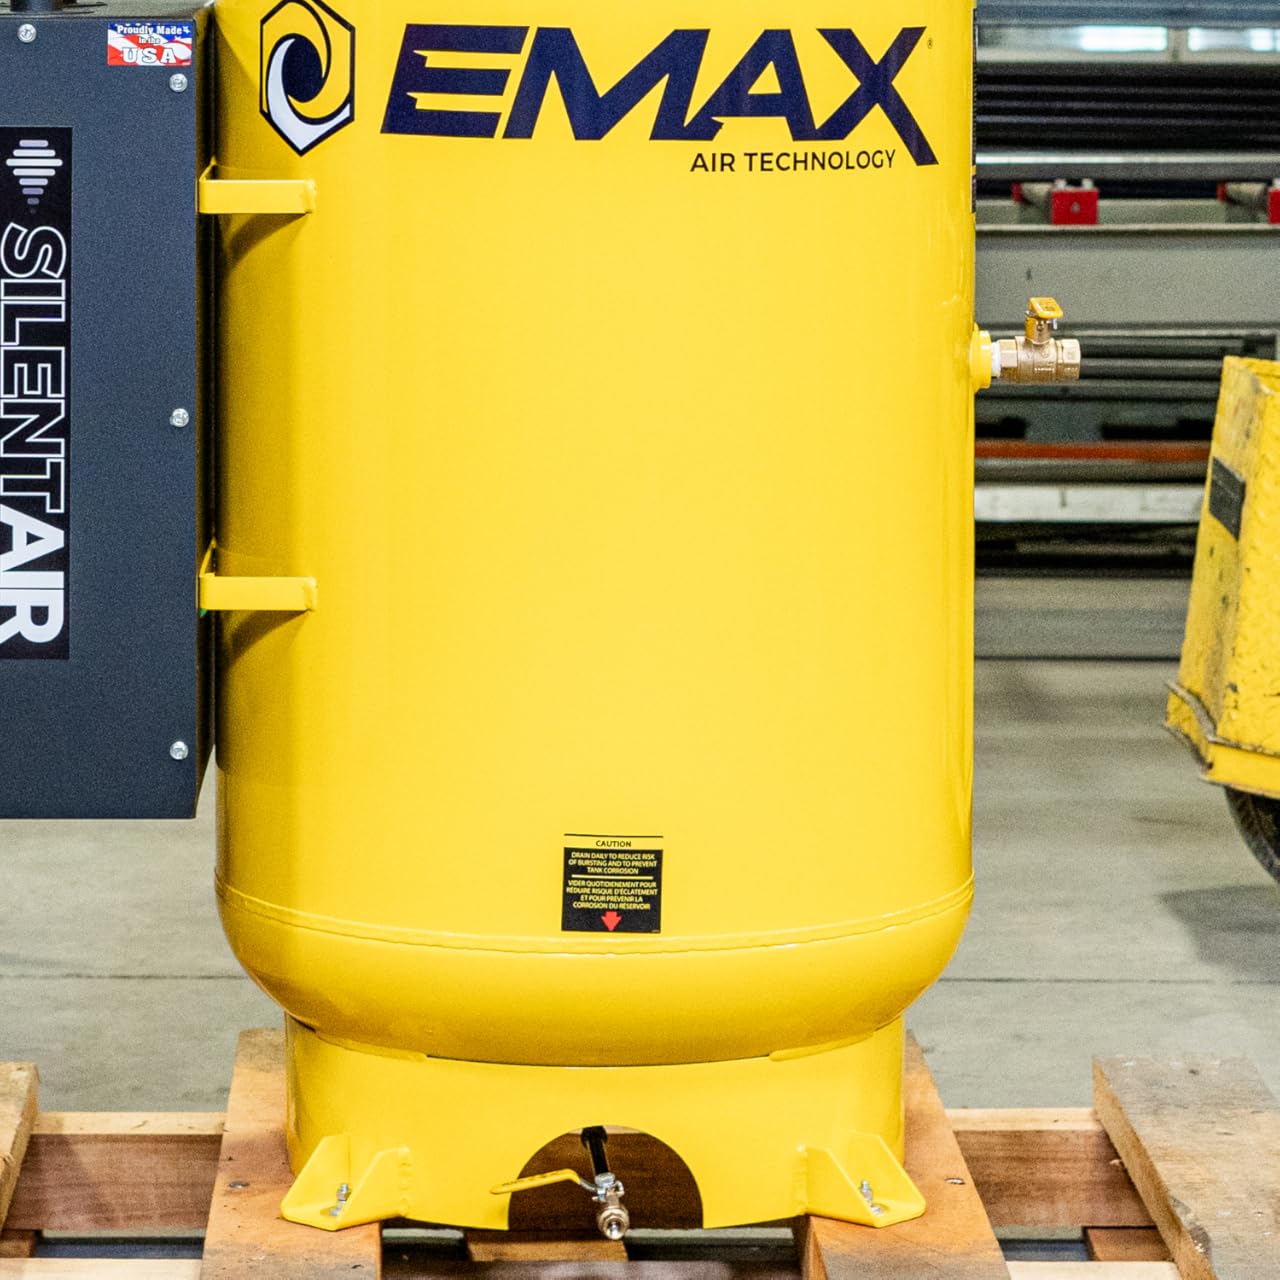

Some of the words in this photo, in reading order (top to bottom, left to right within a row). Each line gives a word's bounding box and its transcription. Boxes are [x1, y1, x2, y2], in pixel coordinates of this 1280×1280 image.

[117, 25, 154, 36] Proudly
[156, 26, 182, 34] Made
[122, 47, 177, 64] USA
[380, 22, 940, 167] EMAX
[690, 152, 736, 172] AIR
[744, 149, 896, 172] TECHNOLOGY
[596, 840, 632, 848] CAUTION
